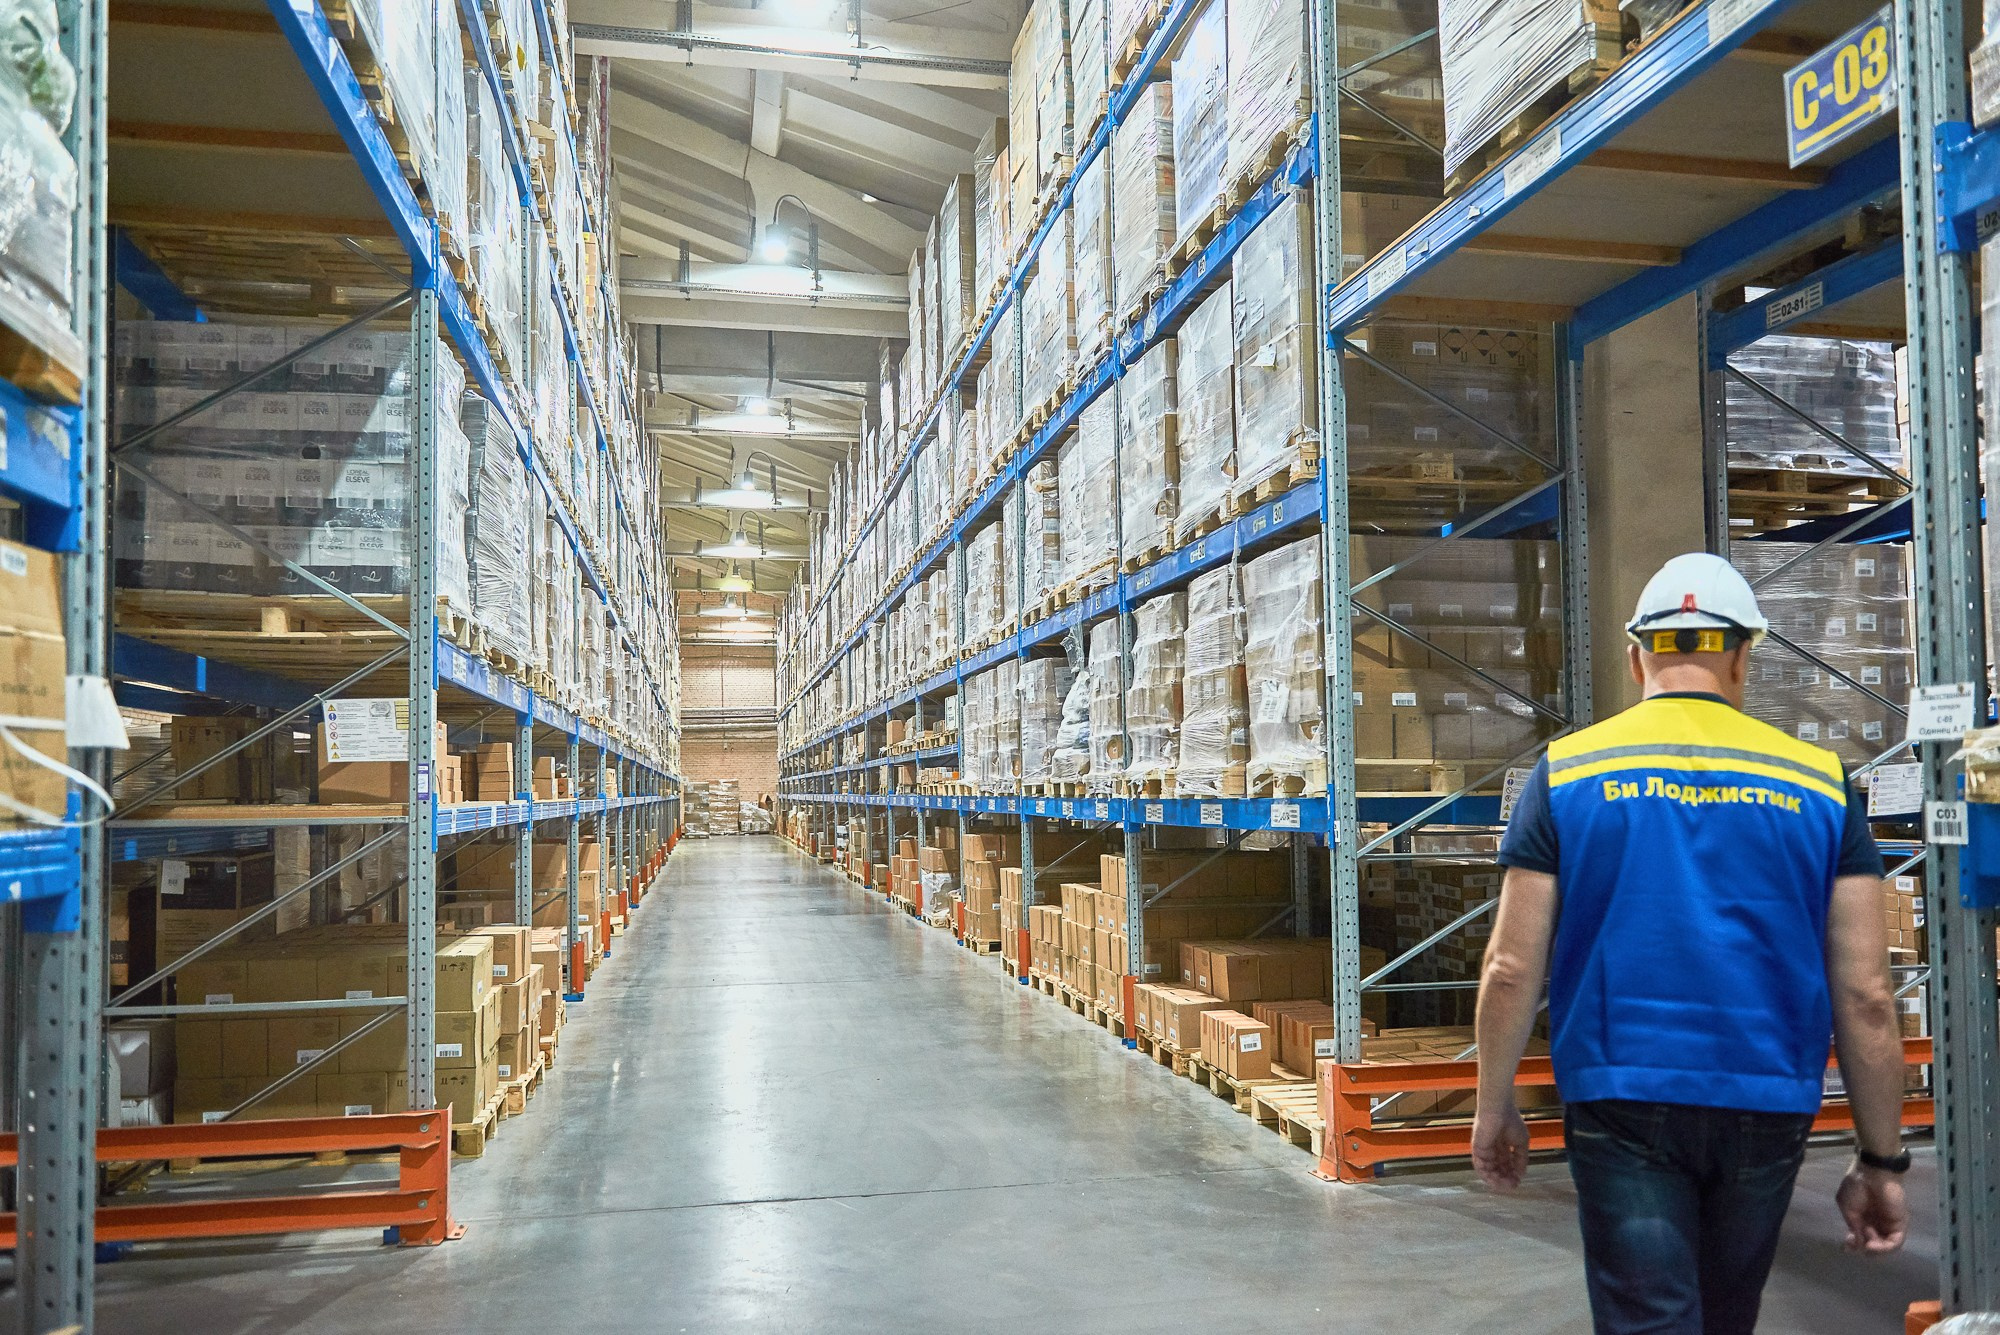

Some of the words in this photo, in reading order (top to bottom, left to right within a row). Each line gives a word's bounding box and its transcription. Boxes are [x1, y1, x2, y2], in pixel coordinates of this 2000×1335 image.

[1792, 25, 1889, 131] C-03
[1781, 296, 1804, 317] 02-81
[1603, 780, 1639, 802] Би
[1644, 776, 1802, 814] Лоджистик
[1936, 808, 1957, 819] C03
